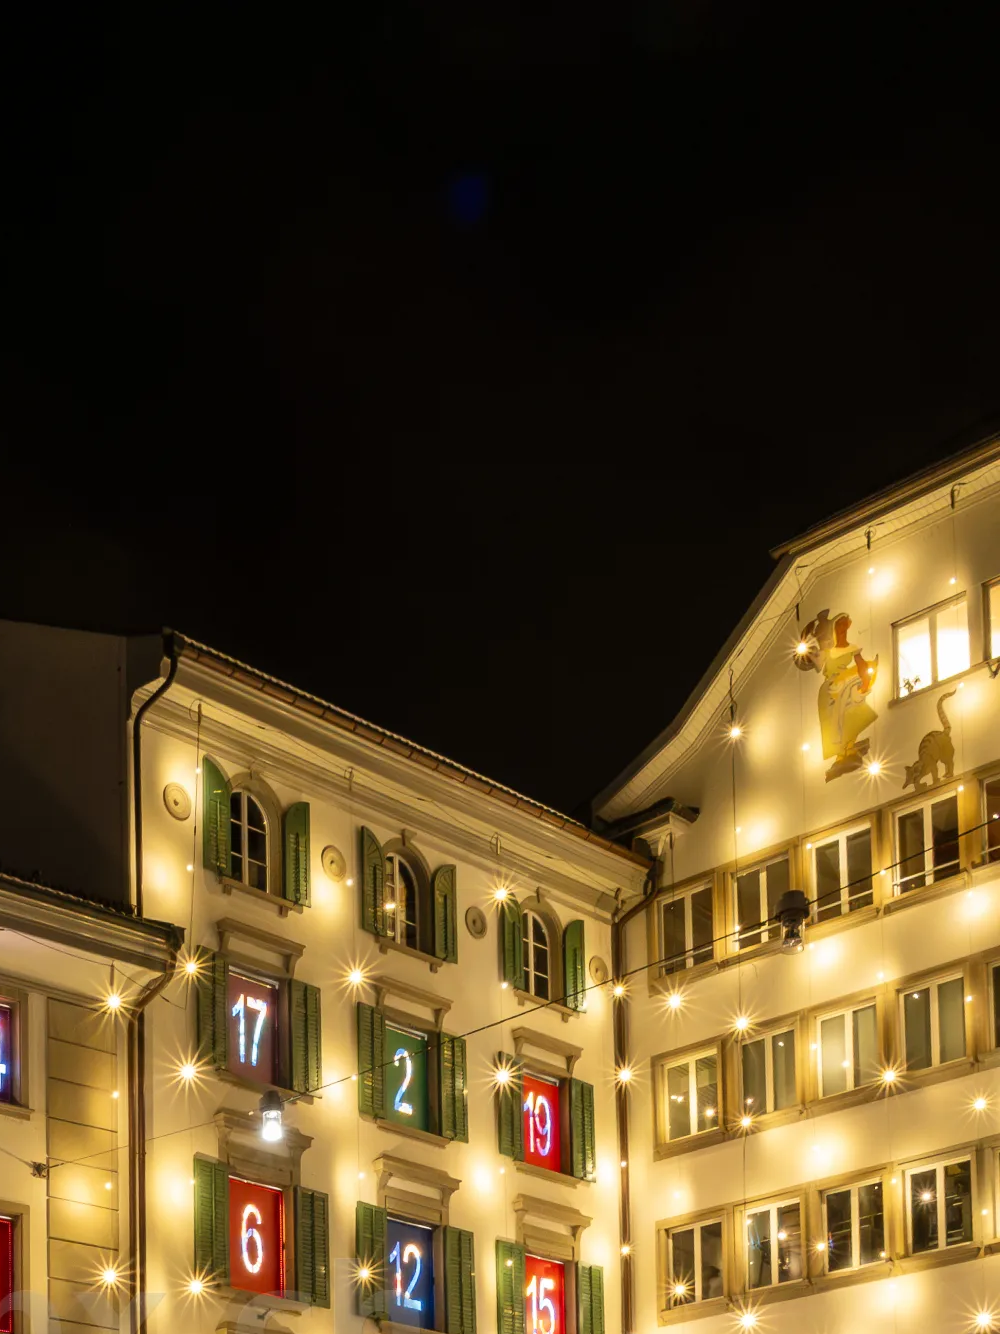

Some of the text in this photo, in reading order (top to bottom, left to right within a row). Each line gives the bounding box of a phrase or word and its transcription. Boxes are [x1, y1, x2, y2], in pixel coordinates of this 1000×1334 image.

[232, 994, 269, 1066] 17
[394, 1048, 413, 1116] 2
[521, 1091, 553, 1156] 19
[240, 1203, 264, 1275] 6
[390, 1242, 422, 1311] 12
